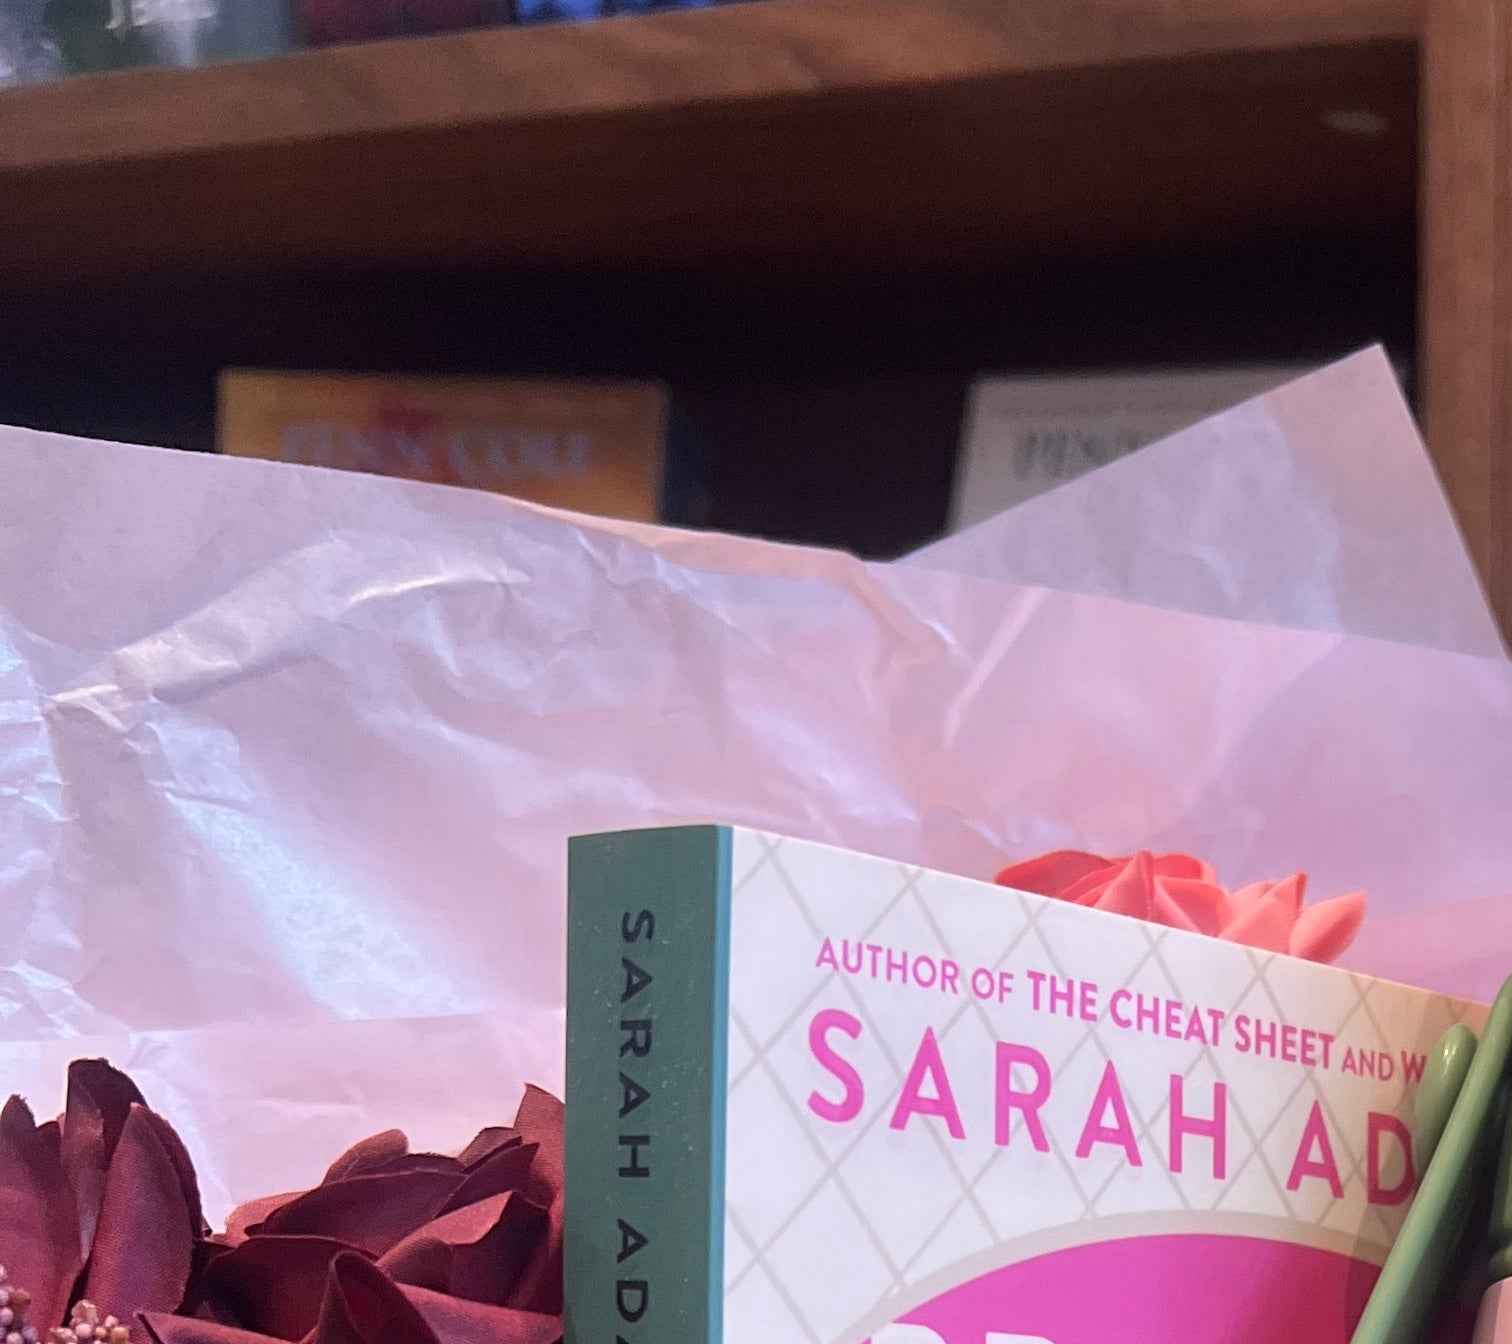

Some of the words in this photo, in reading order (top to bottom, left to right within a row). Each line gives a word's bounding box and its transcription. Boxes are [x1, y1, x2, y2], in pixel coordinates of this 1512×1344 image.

[617, 907, 655, 1178] SARAH
[806, 1008, 1228, 1180] SARAH
[816, 936, 959, 995] AUTHOR
[972, 968, 1014, 1003] OF
[1027, 970, 1098, 1022] THE
[1109, 988, 1225, 1047] CHEAT
[1234, 1014, 1335, 1069] SHEET
[1341, 1046, 1394, 1081] AND
